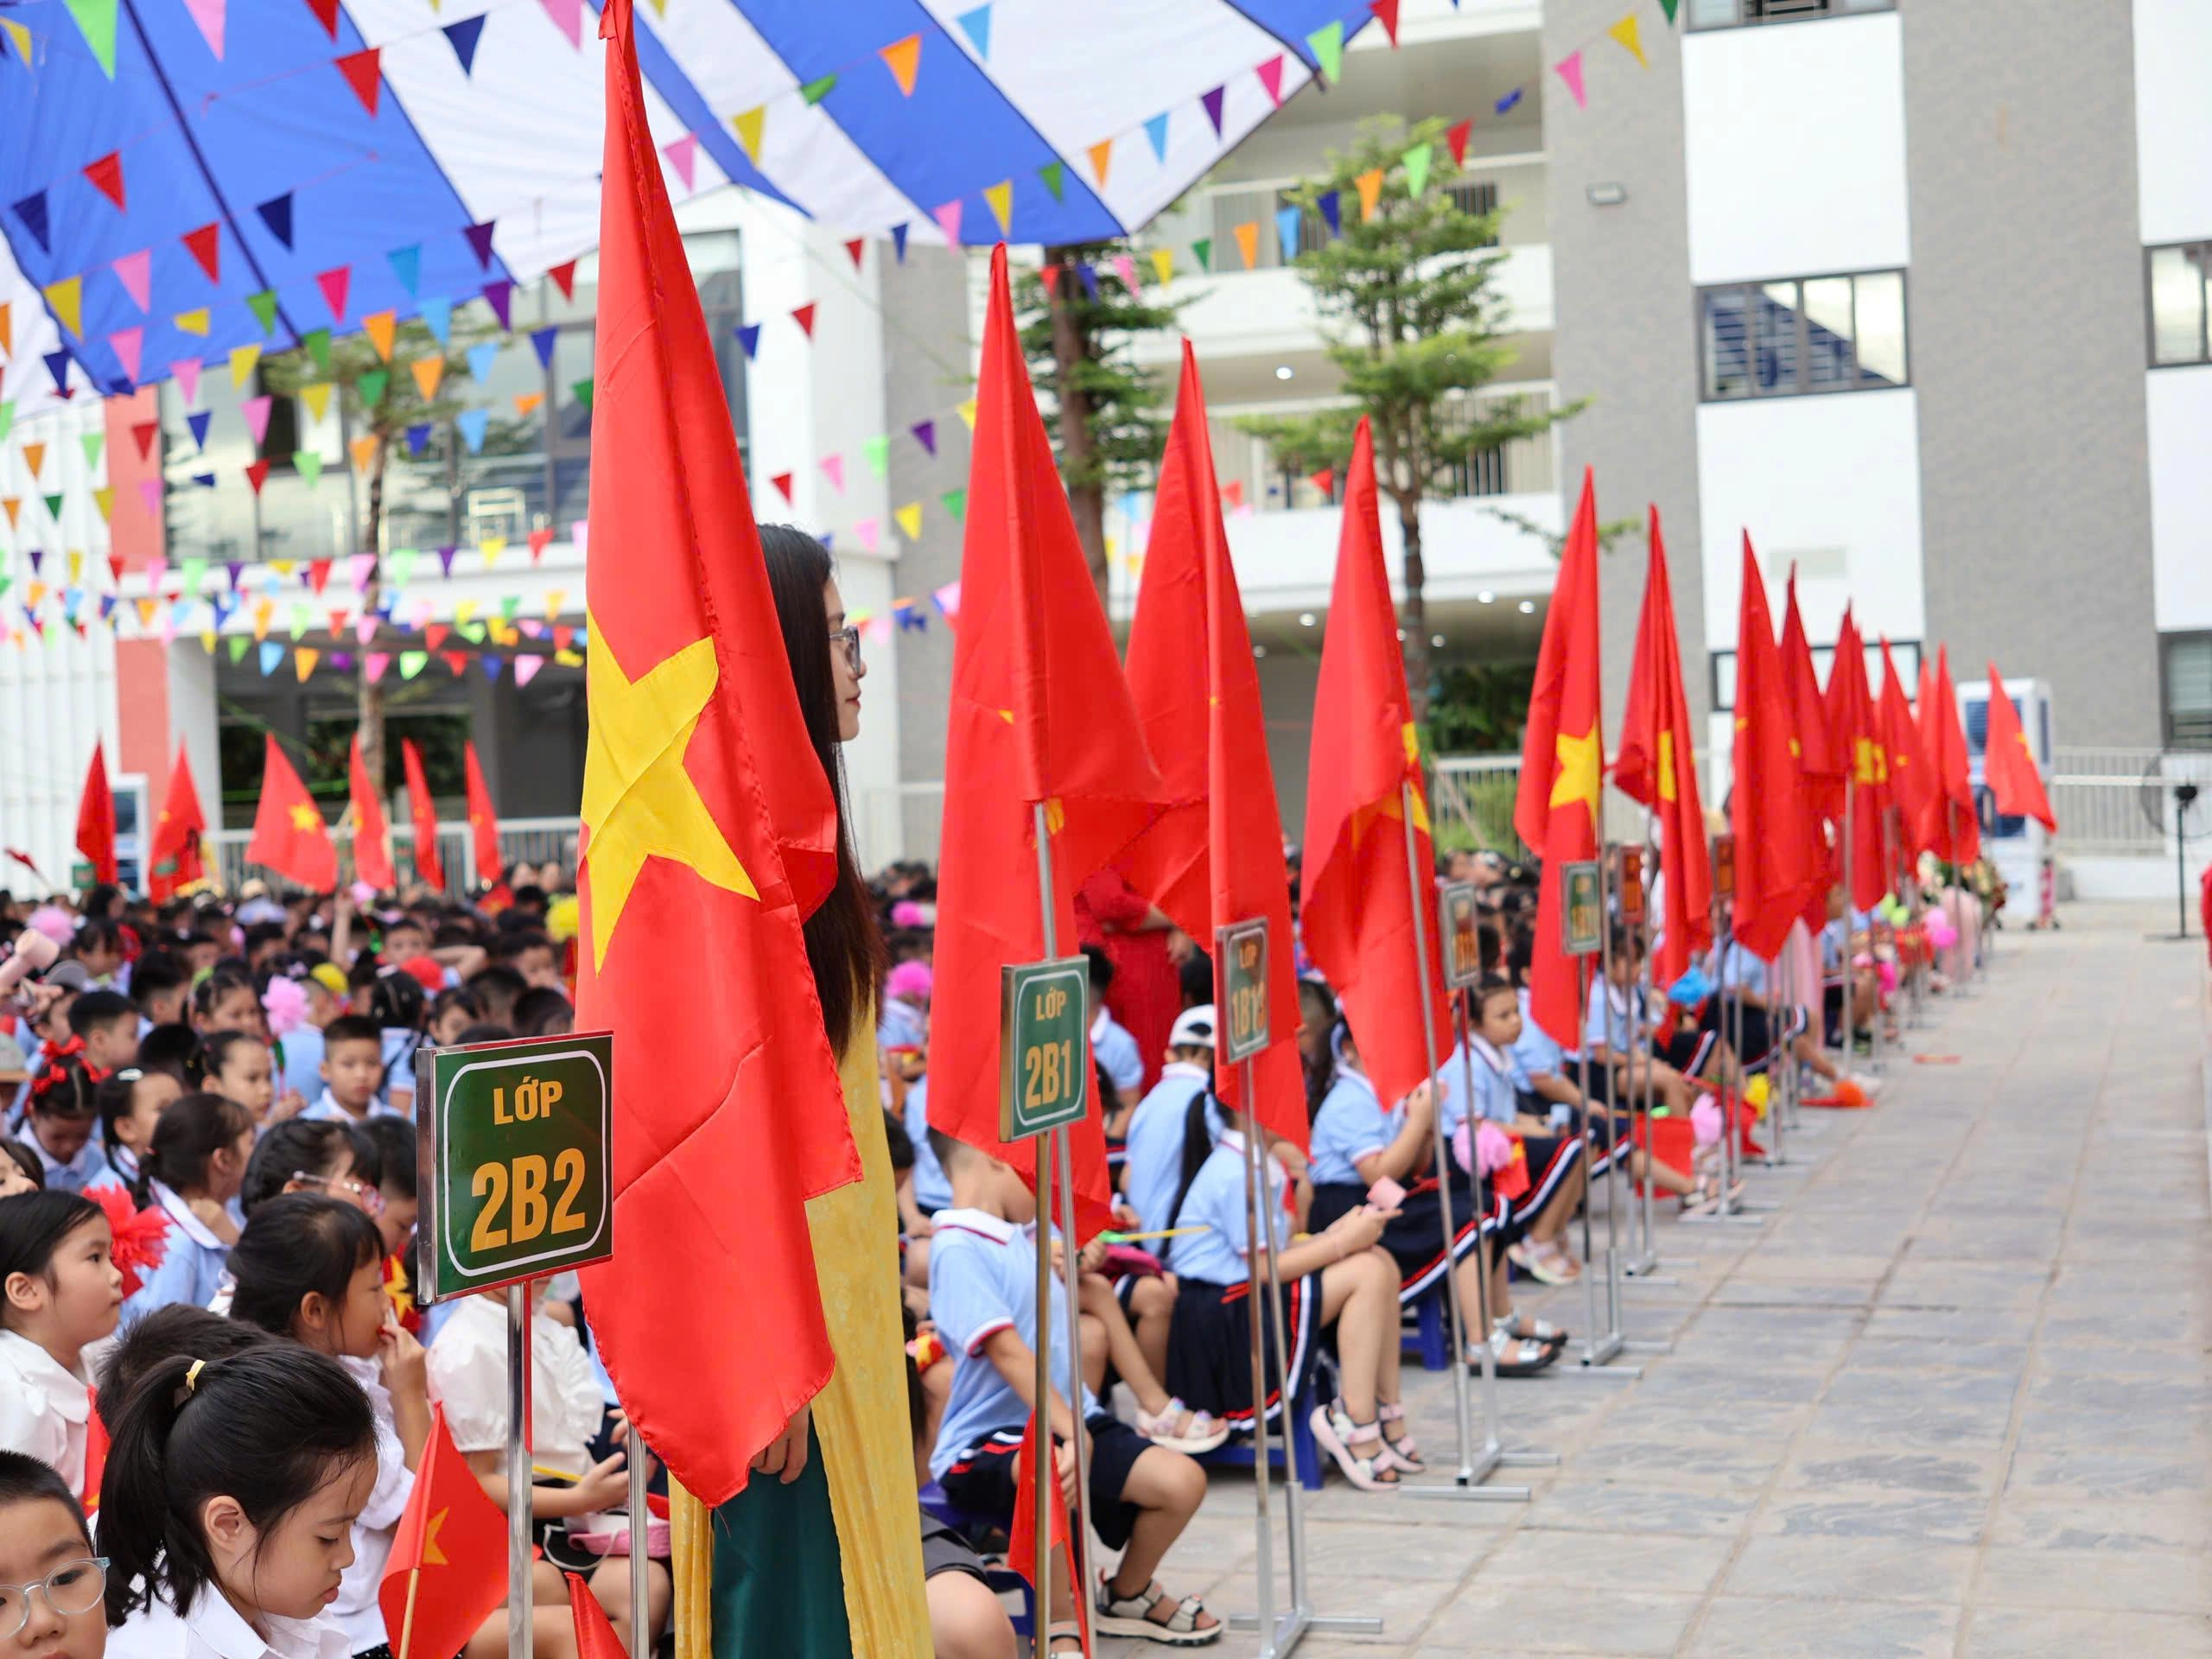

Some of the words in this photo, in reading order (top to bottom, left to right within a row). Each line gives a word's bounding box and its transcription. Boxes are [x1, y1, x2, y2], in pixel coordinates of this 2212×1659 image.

[1035, 987, 1067, 1021] LỚP
[493, 1075, 563, 1125] LỚP
[1025, 1039, 1071, 1109] 2B1
[470, 1147, 586, 1253] 2B2
